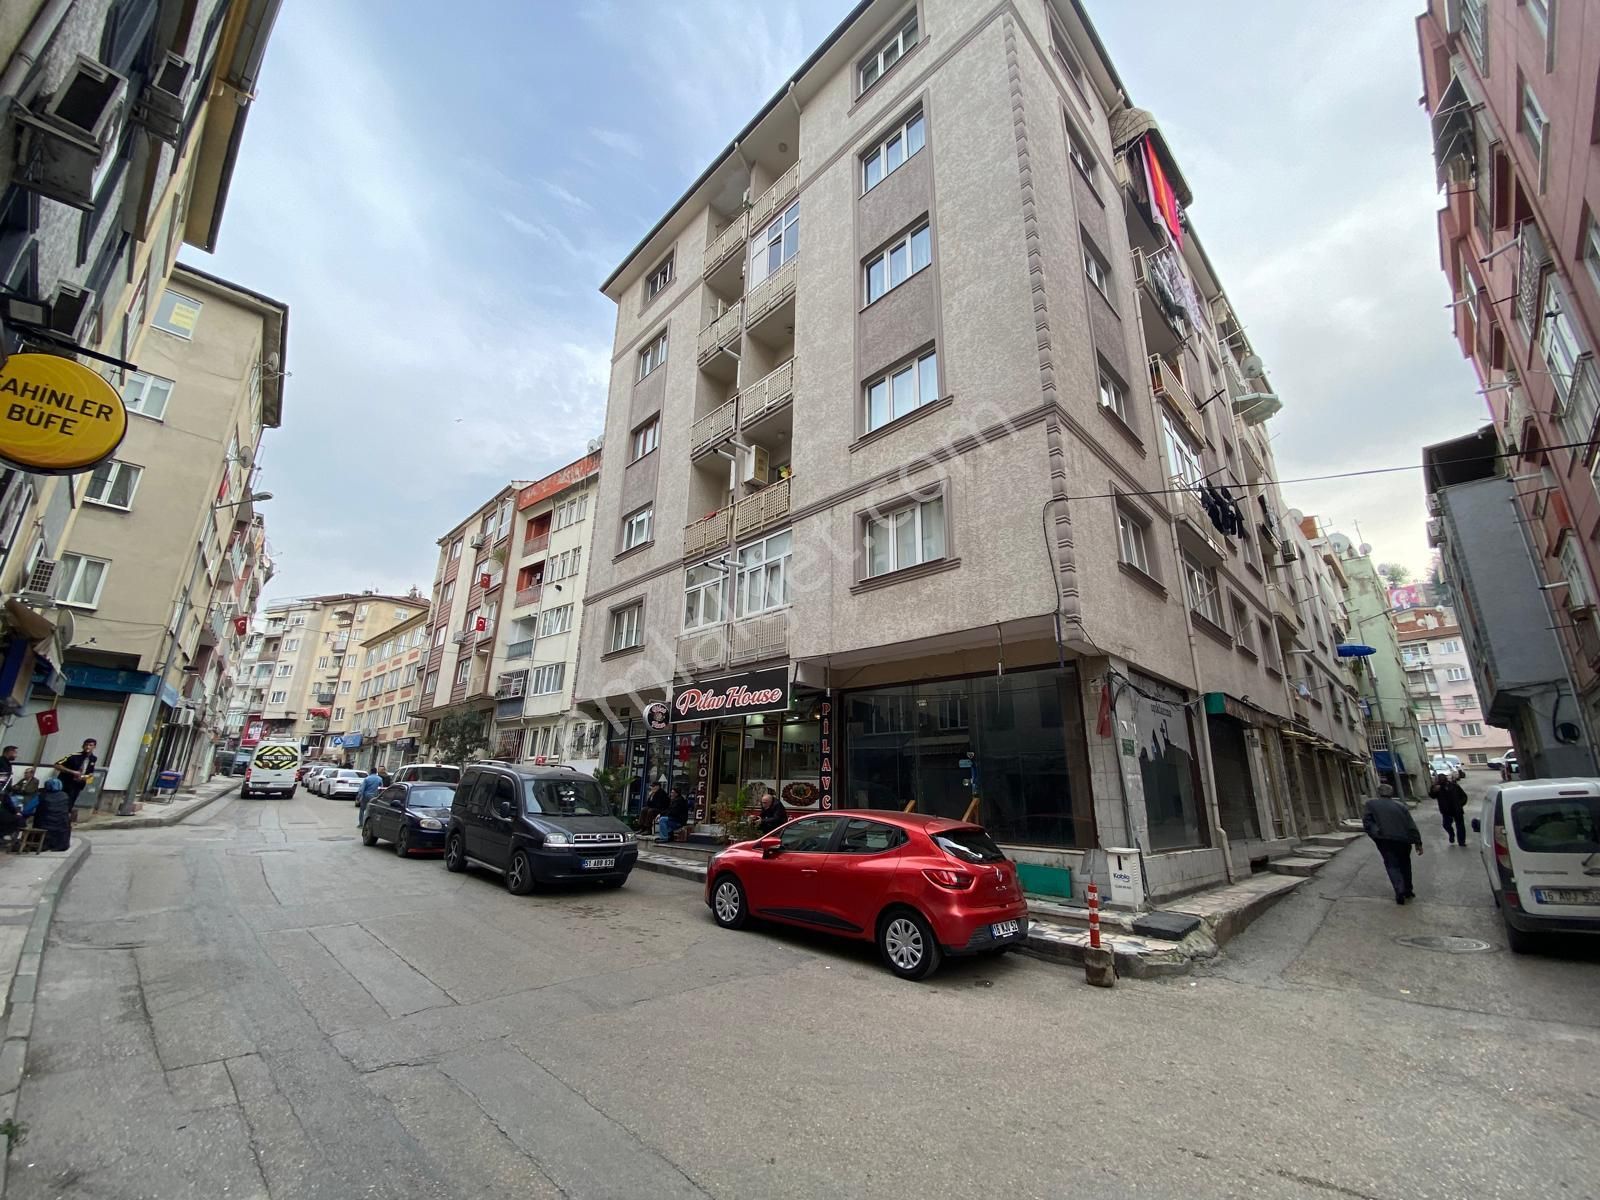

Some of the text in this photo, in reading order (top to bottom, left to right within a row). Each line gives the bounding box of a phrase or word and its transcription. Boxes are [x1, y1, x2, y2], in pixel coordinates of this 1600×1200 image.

[0, 374, 113, 422] AHİNLER
[6, 403, 78, 436] BÜFE
[676, 684, 783, 716] Pilav House
